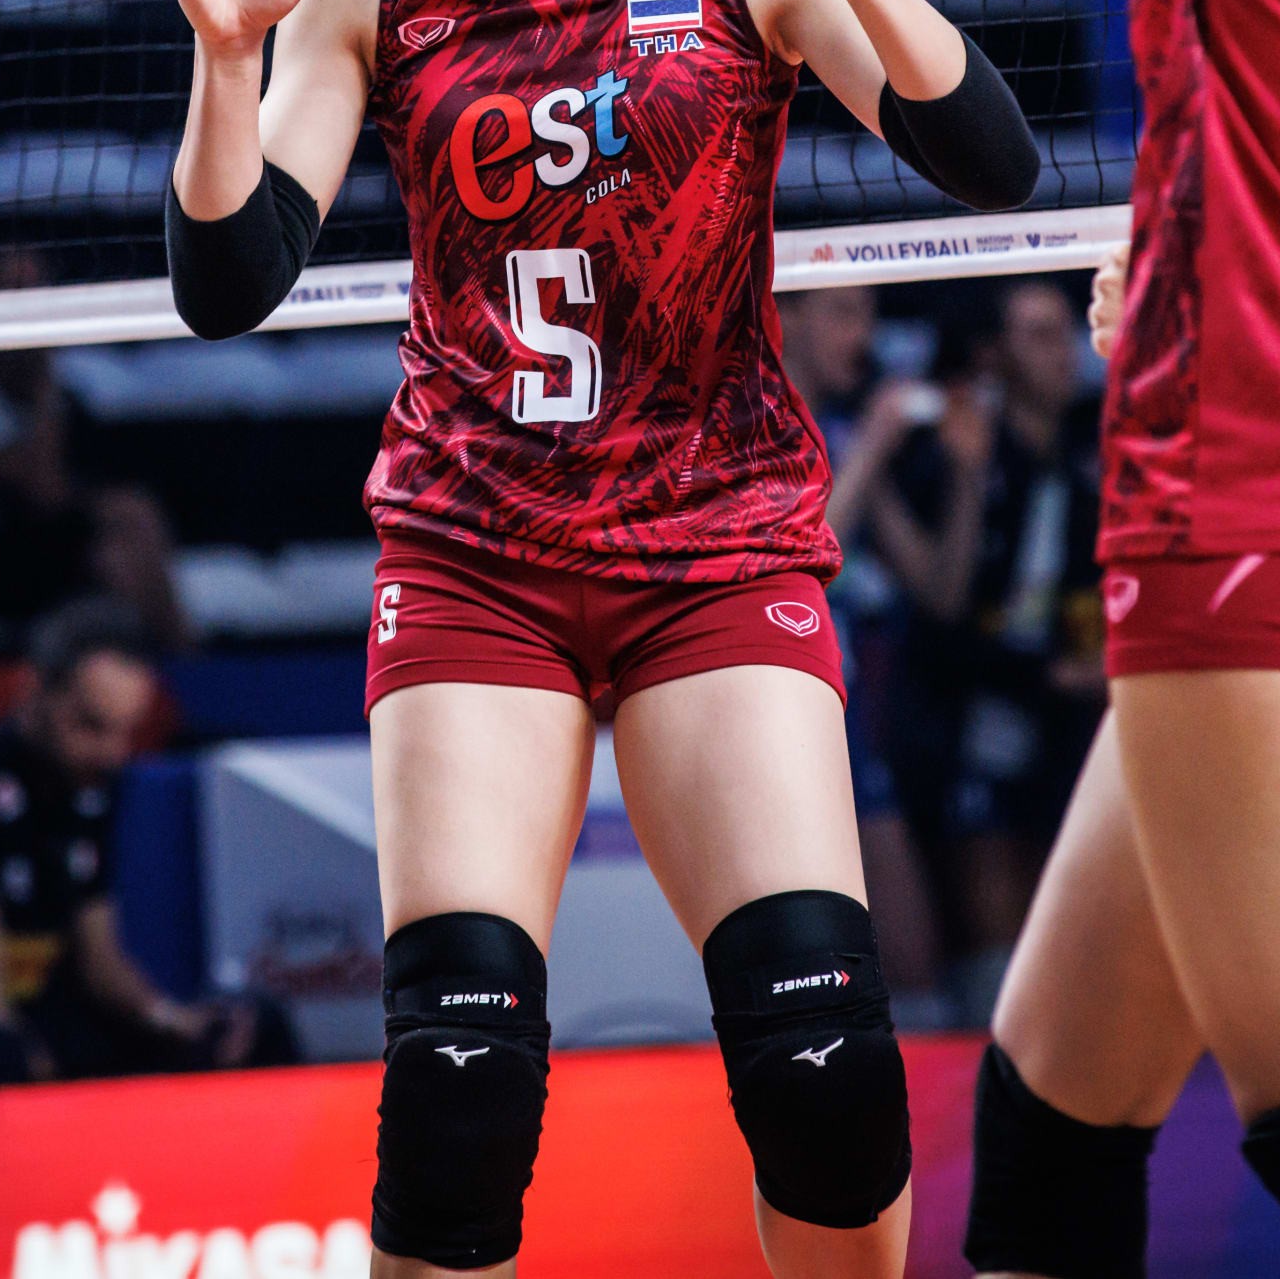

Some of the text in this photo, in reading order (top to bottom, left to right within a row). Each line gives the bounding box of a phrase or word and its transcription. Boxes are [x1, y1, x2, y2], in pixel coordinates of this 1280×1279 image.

[630, 32, 705, 57] THA
[448, 70, 629, 220] est
[586, 168, 631, 204] COLA
[846, 237, 971, 263] VOLLEYBALL
[506, 248, 602, 423] 5
[378, 584, 401, 643] 5
